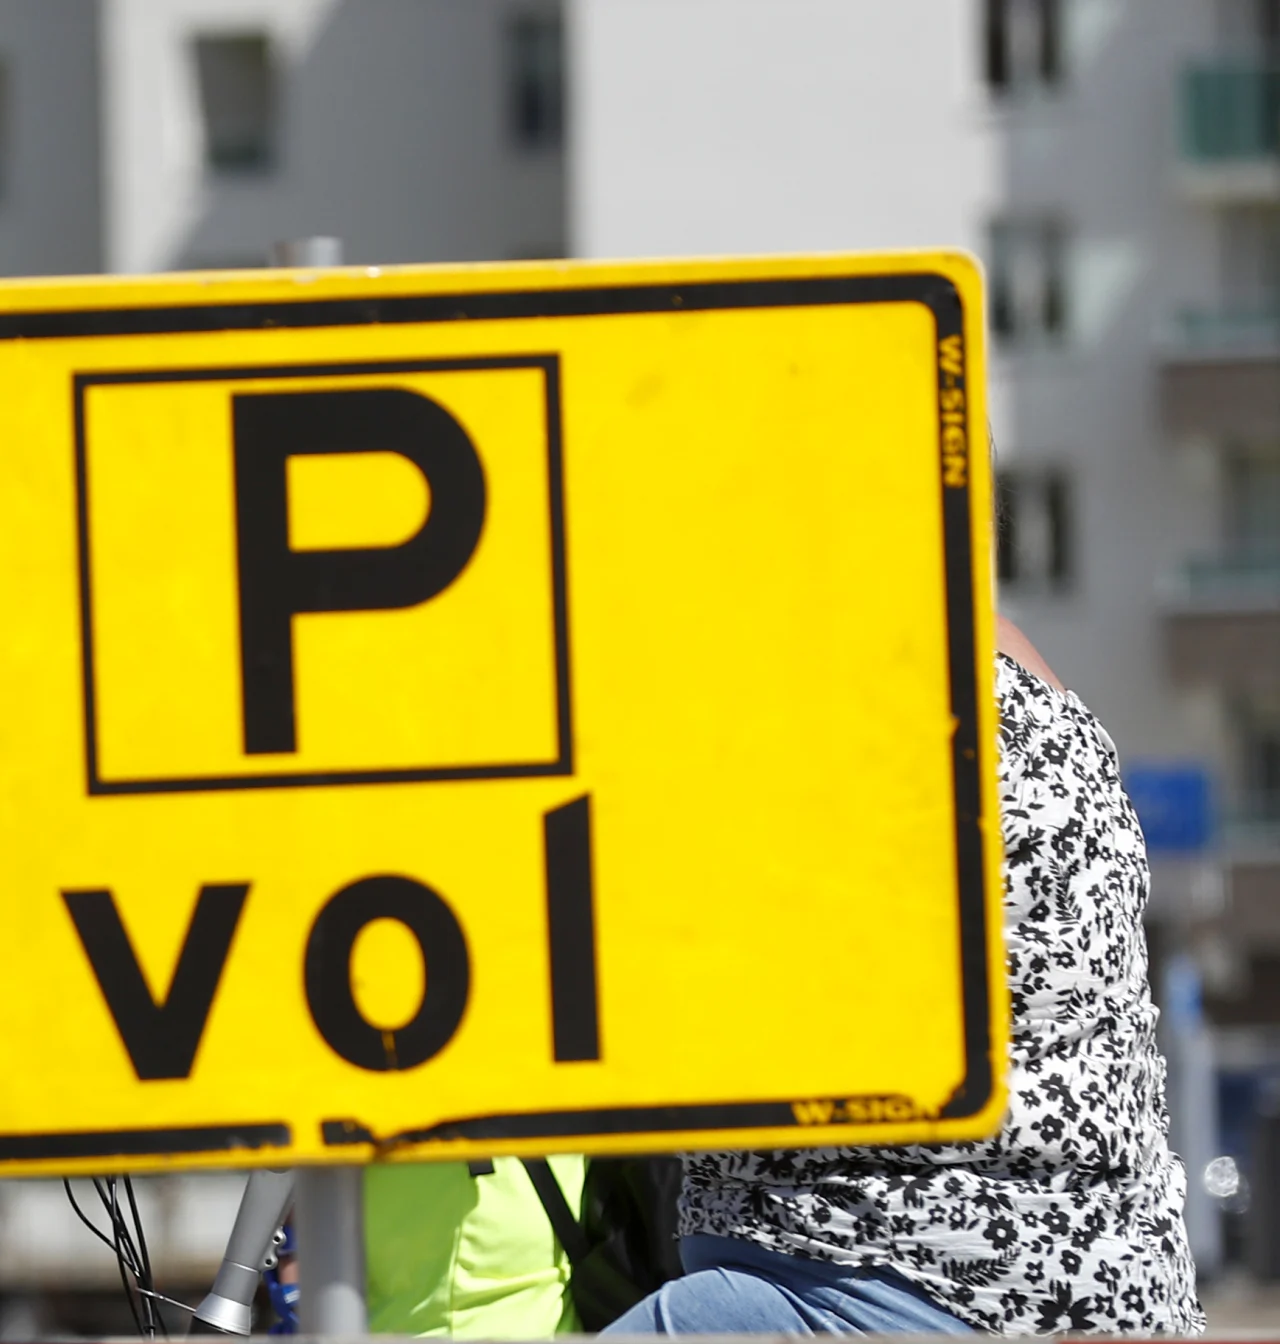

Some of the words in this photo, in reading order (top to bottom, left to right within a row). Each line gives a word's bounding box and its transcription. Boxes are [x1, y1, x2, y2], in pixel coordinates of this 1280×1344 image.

[939, 334, 967, 488] W-SIGN
[231, 384, 489, 756] P
[58, 790, 603, 1083] vol
